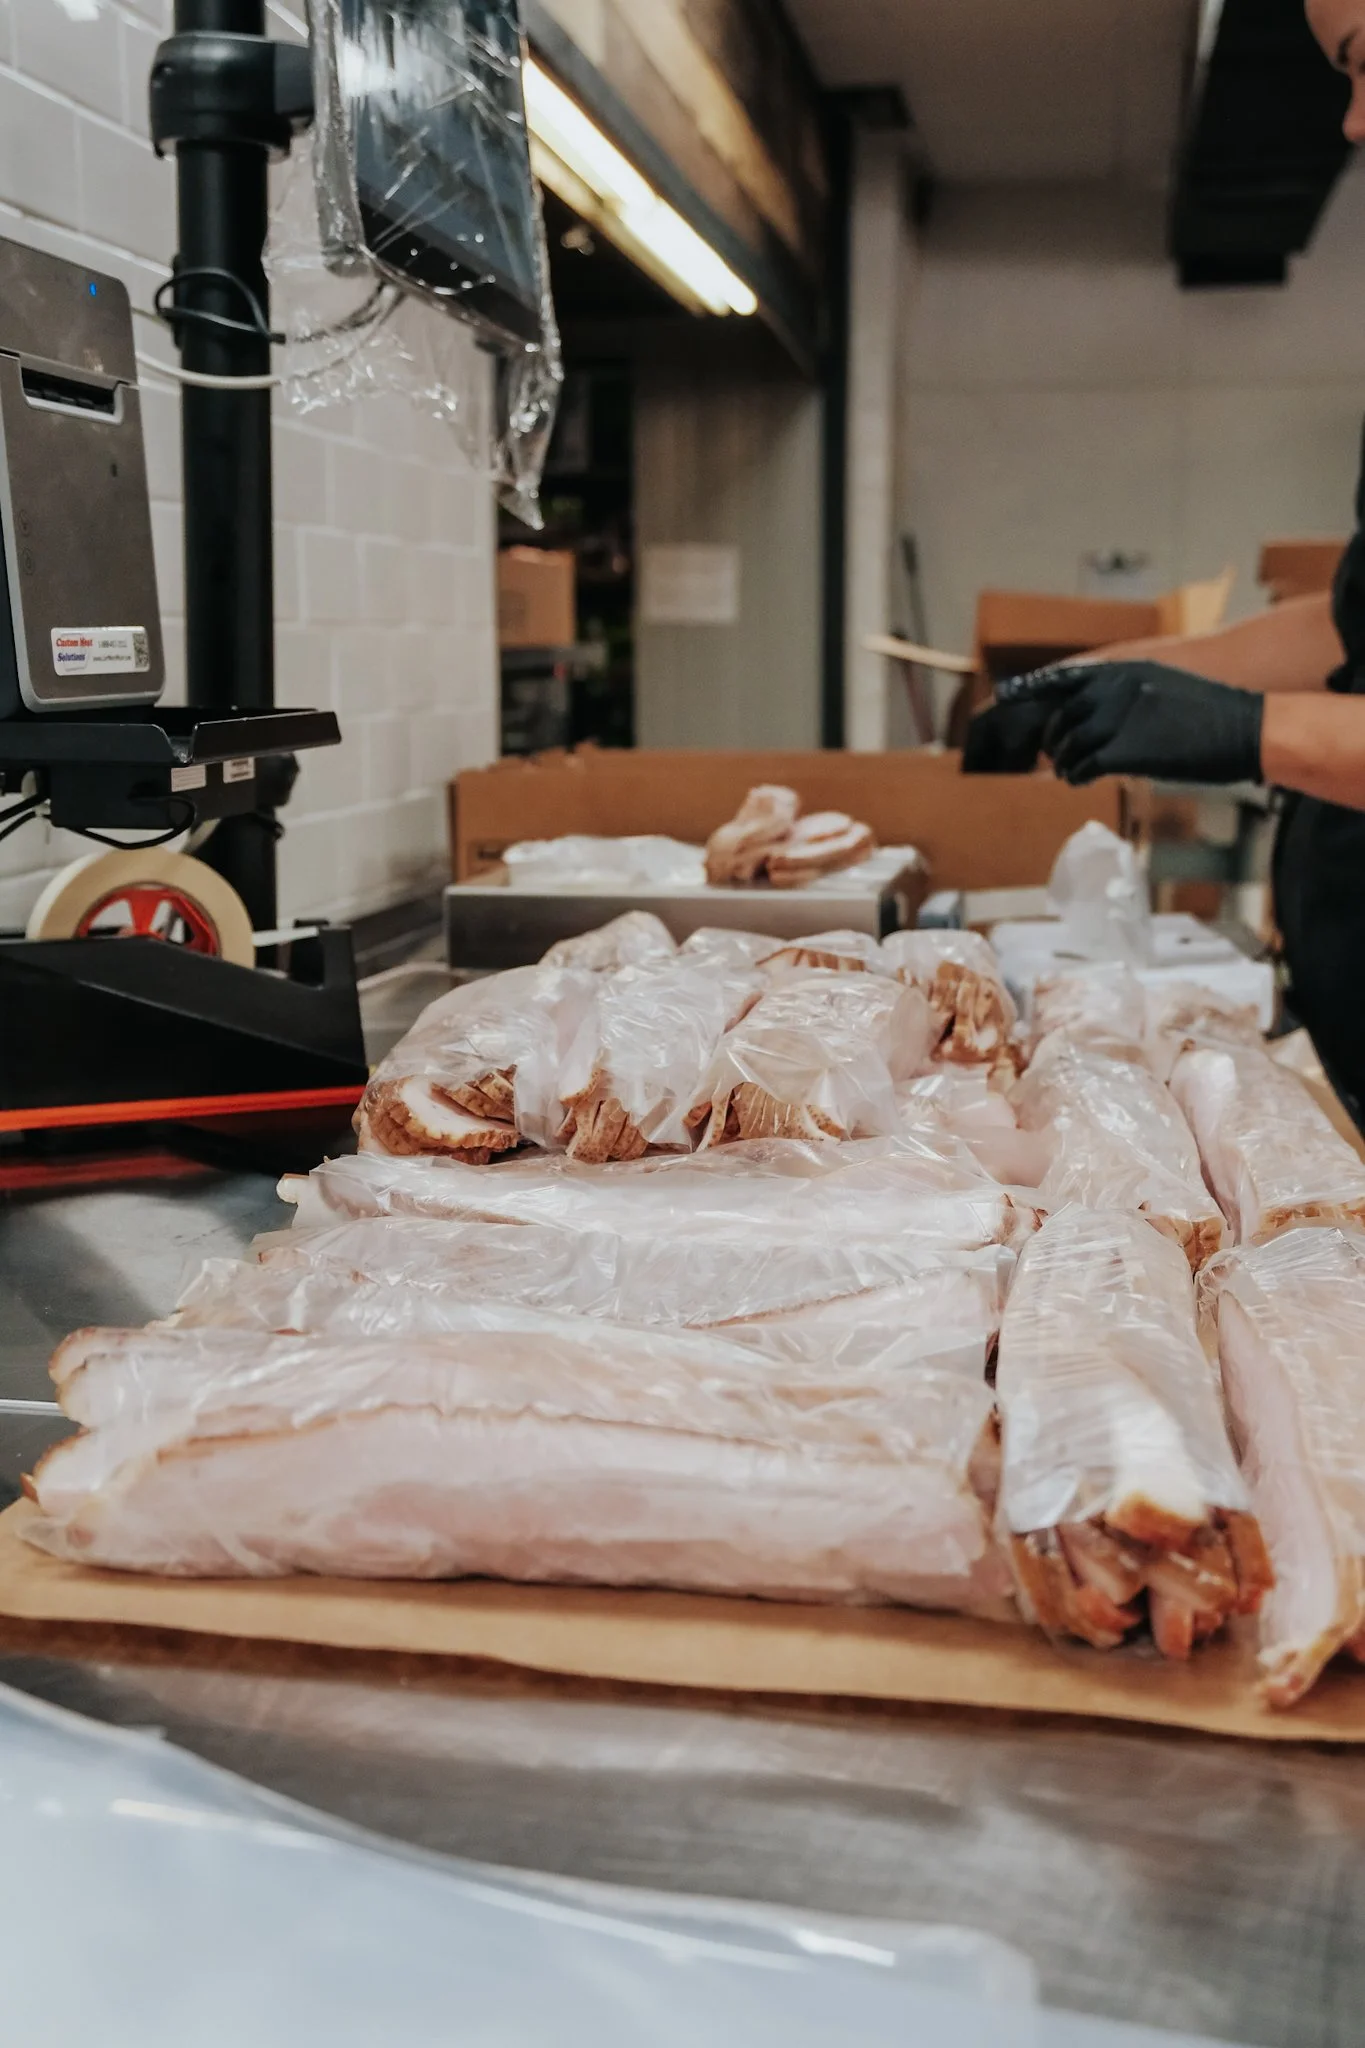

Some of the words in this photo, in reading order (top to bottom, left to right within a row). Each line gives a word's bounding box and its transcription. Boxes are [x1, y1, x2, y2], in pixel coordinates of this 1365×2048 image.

[56, 638, 79, 647] Custom
[80, 636, 93, 647] Meat
[57, 652, 86, 662] Solutions
